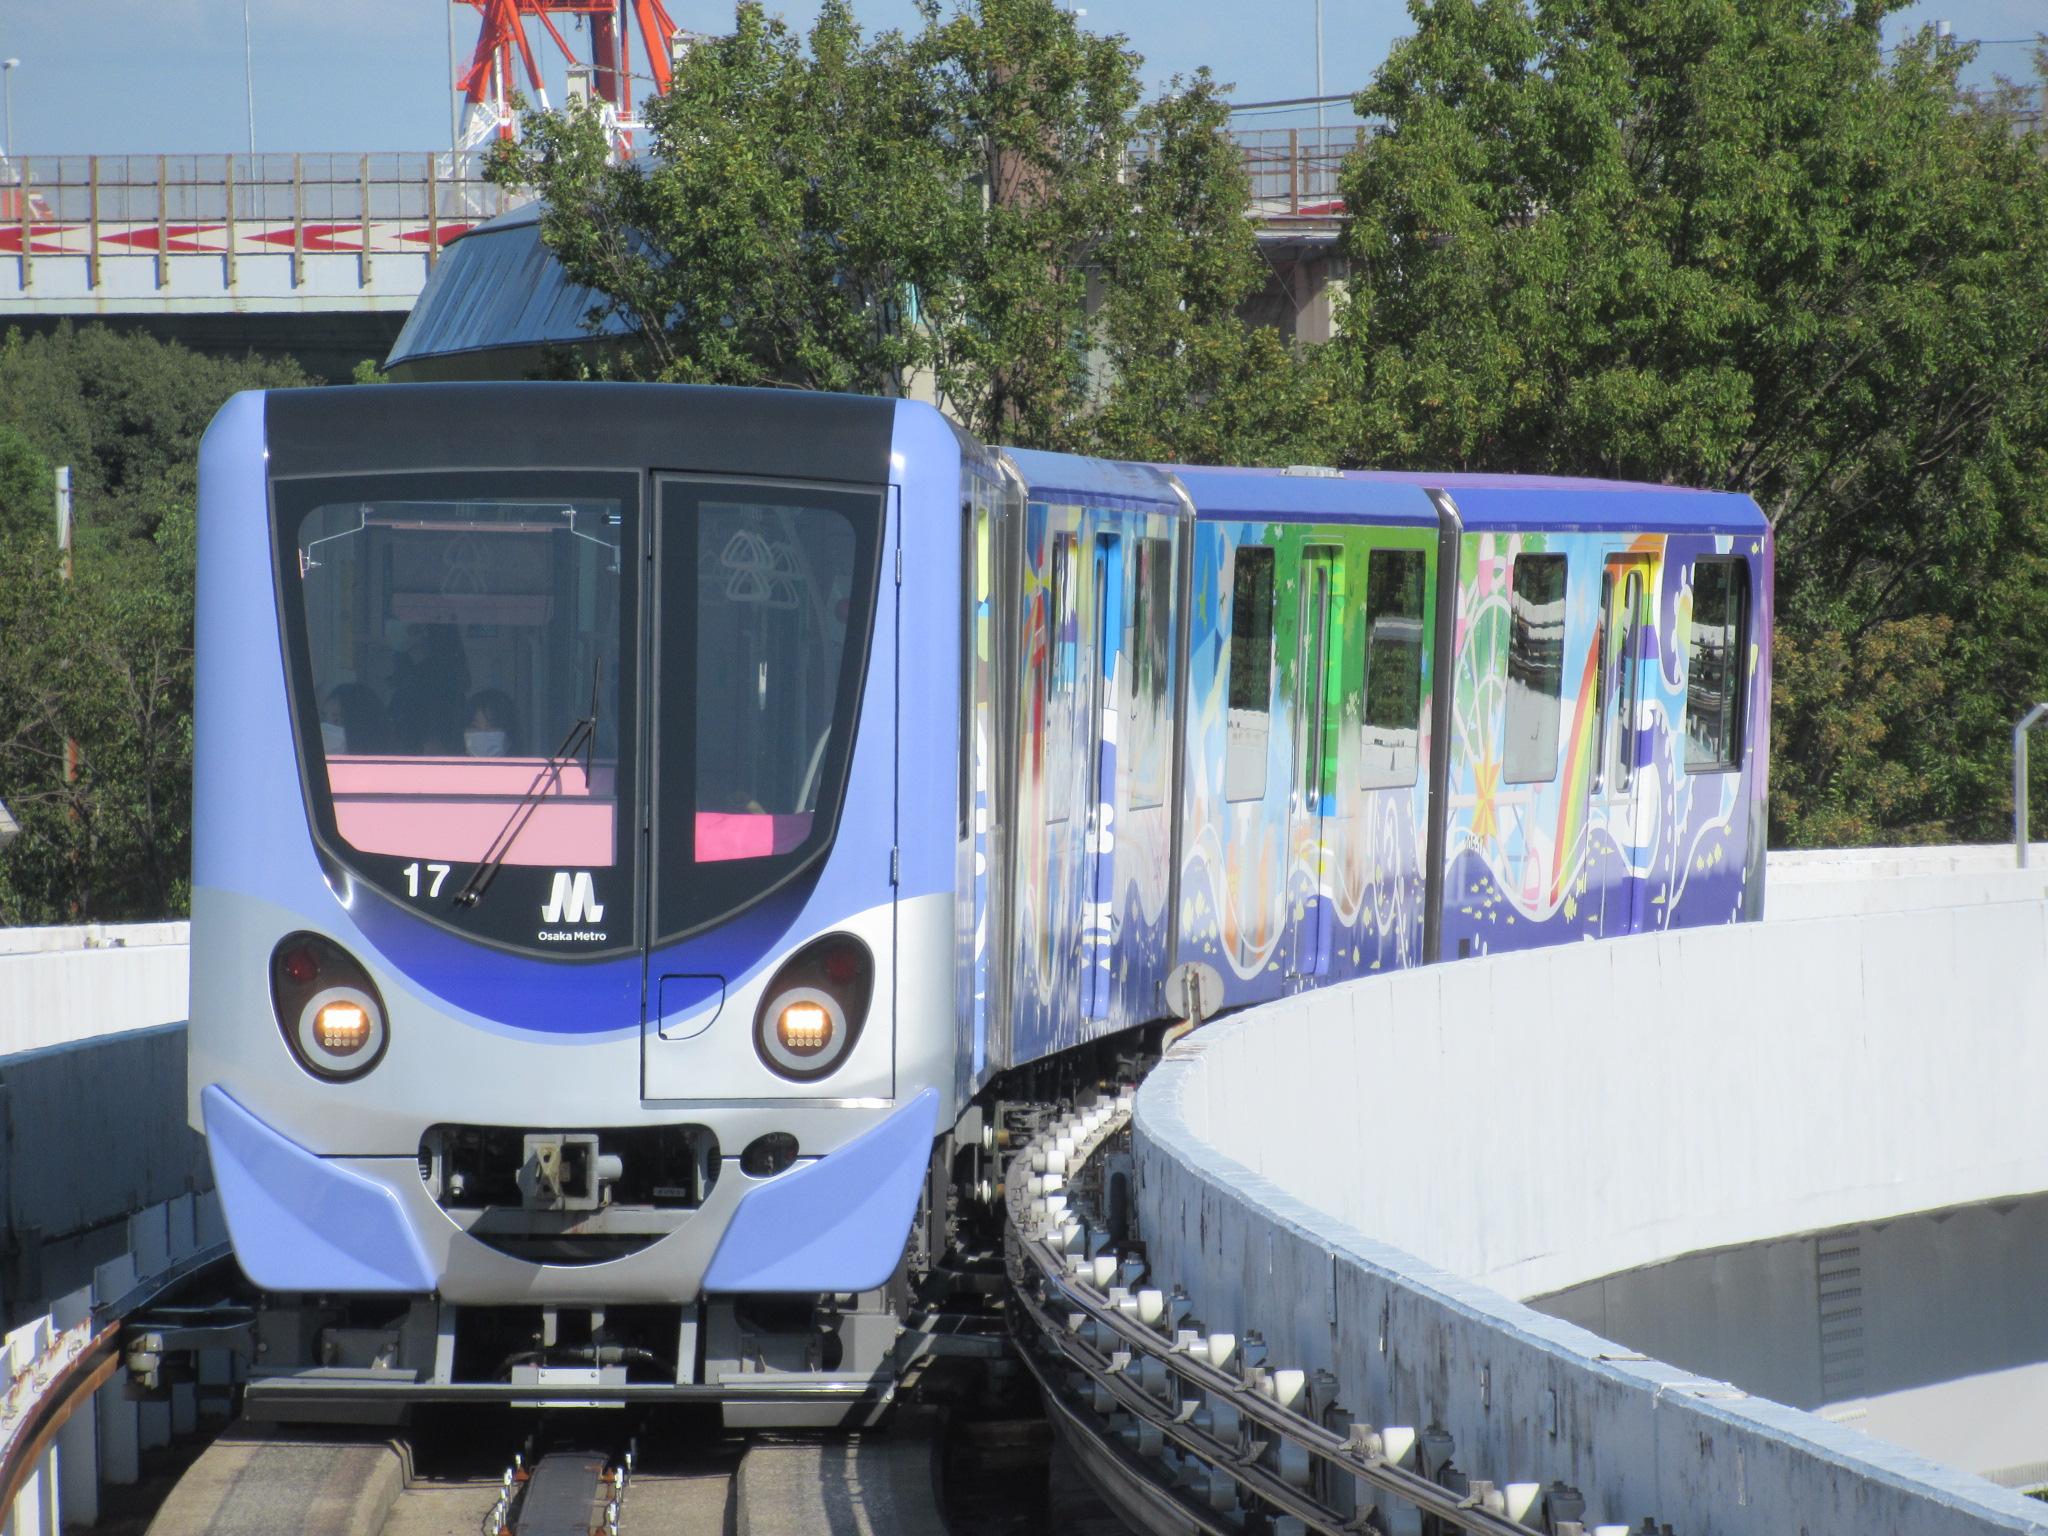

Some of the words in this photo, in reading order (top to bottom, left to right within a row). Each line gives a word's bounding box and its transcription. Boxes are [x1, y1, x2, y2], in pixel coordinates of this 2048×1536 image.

[403, 863, 450, 897] 17
[538, 931, 572, 941] Osaka
[573, 931, 606, 941] Metro
